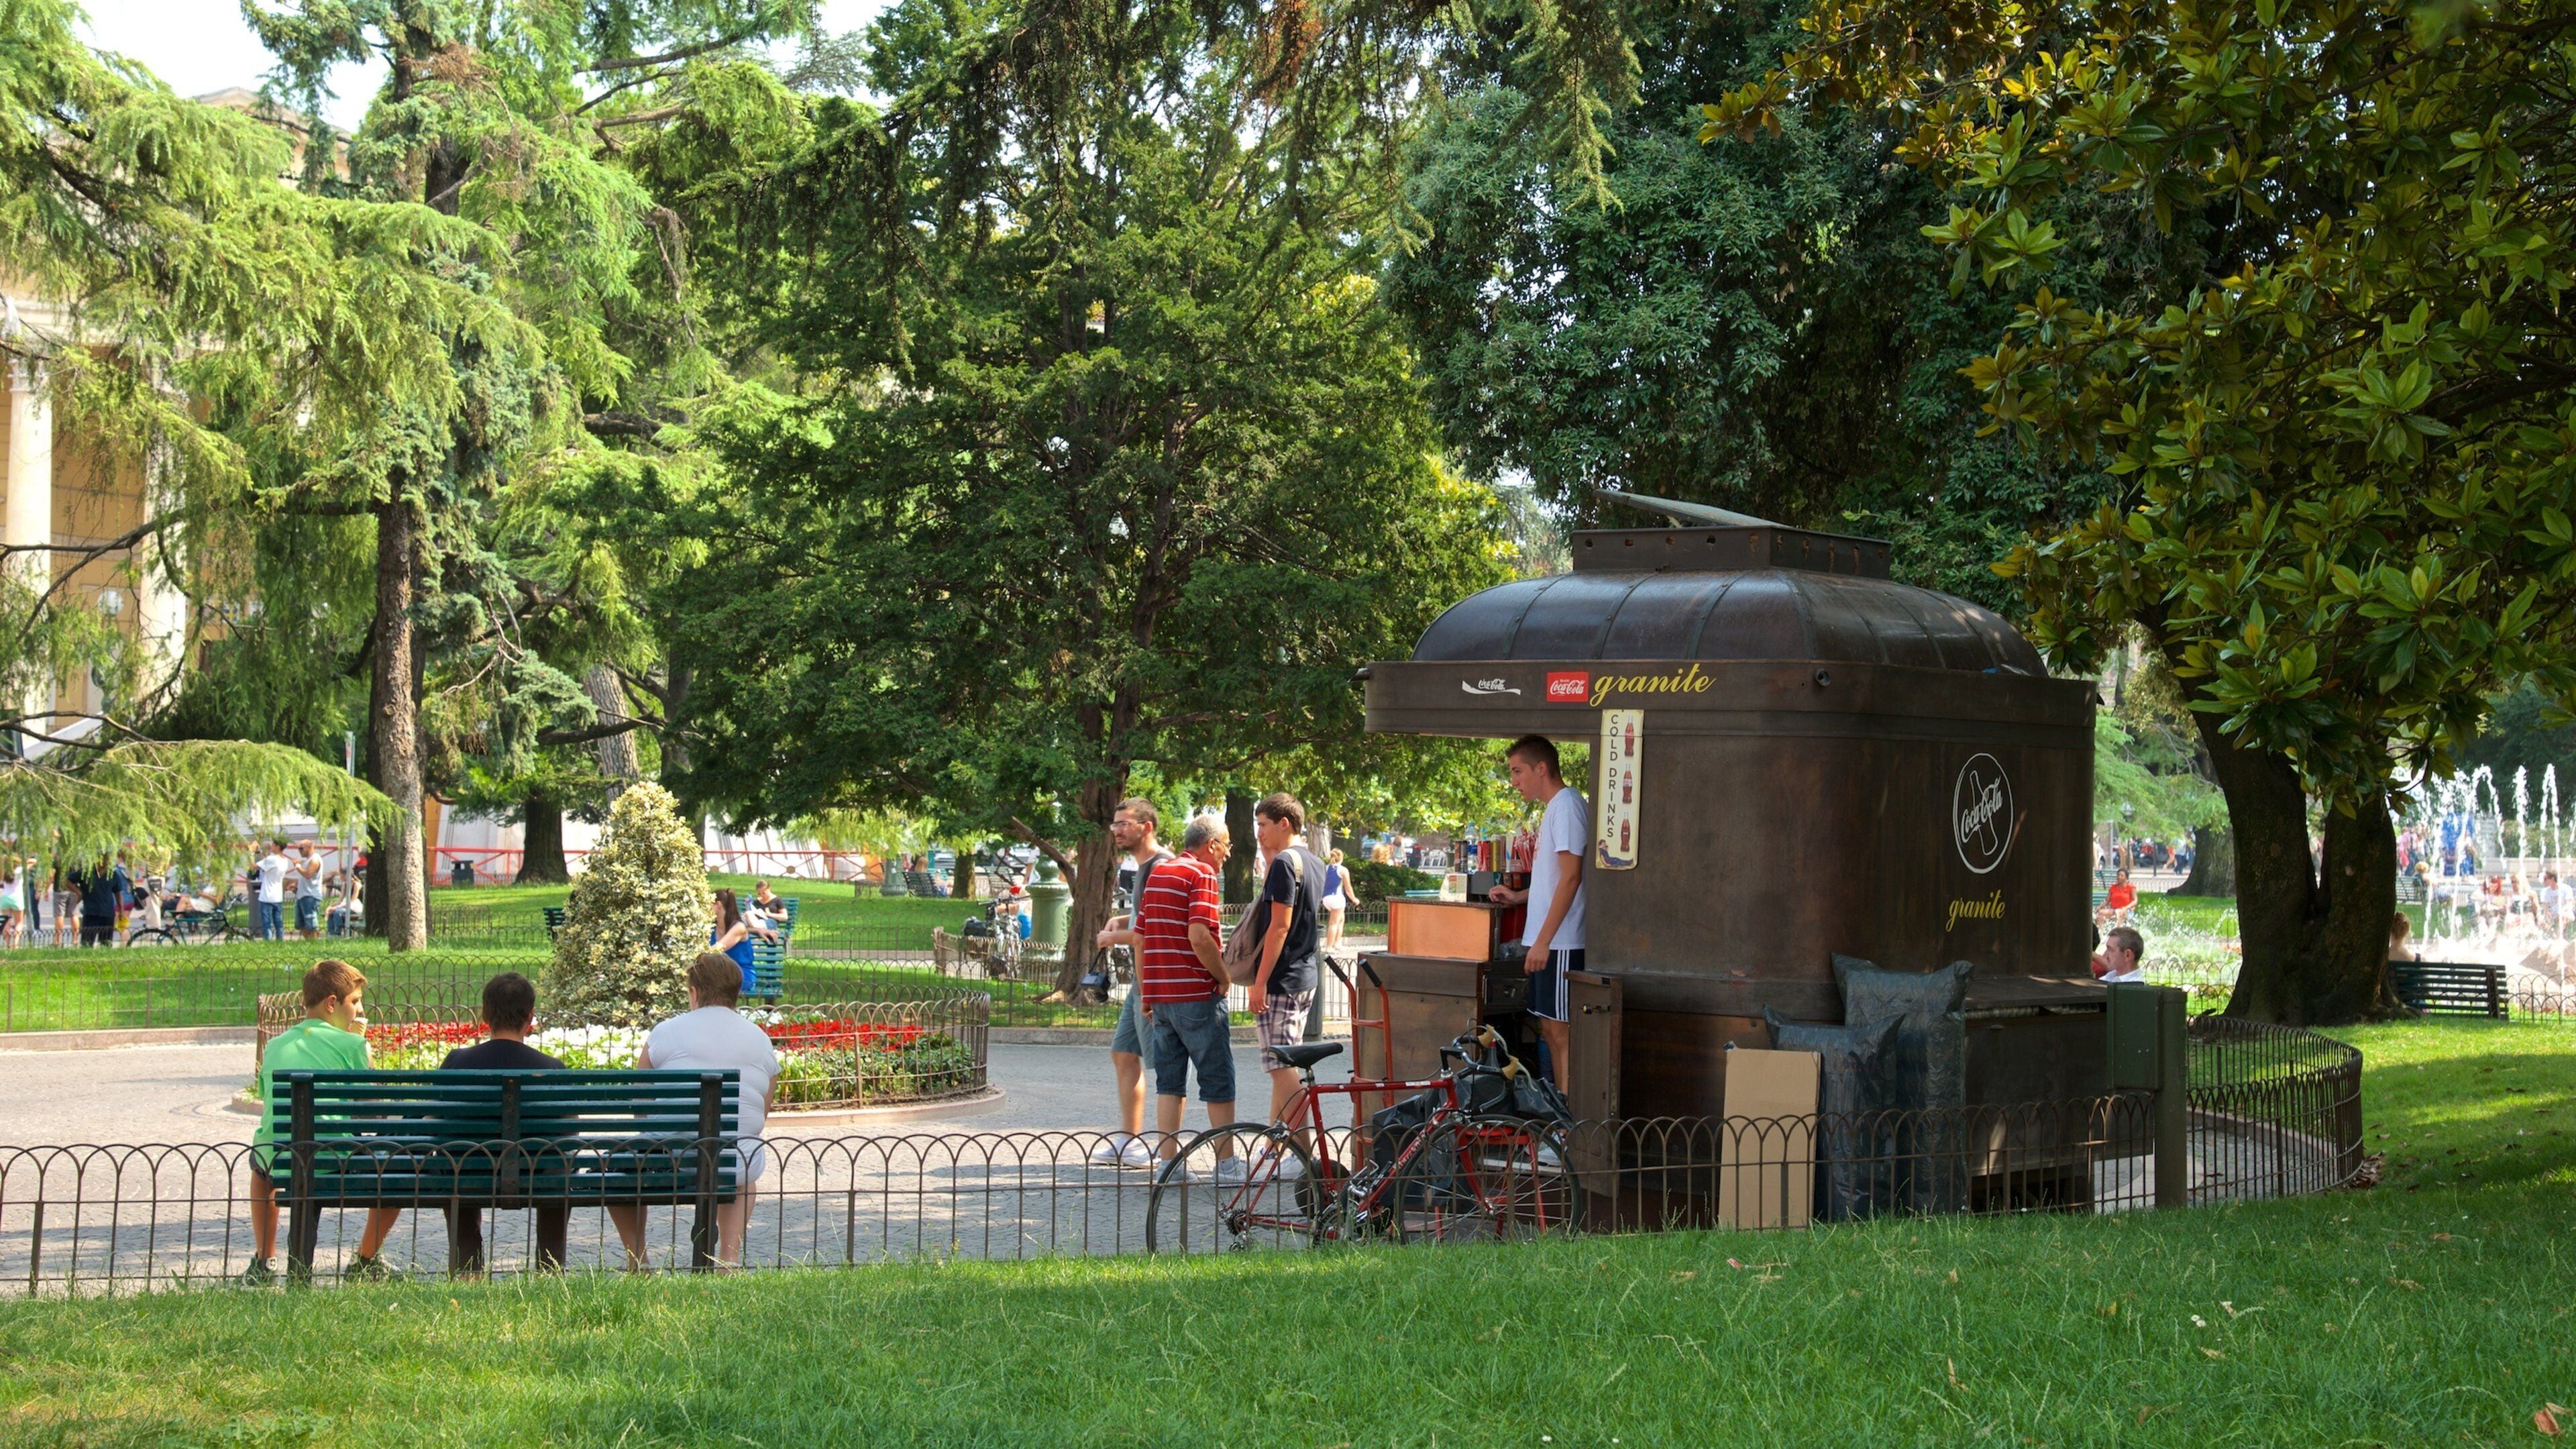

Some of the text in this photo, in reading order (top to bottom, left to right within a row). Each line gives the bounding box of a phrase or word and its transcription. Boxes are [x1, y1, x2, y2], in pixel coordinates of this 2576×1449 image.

[1550, 680, 1586, 695] Coca-Cola
[1589, 663, 1717, 707] granite
[1607, 714, 1619, 838] COLD DRINKS
[1945, 889, 2006, 932] granite
